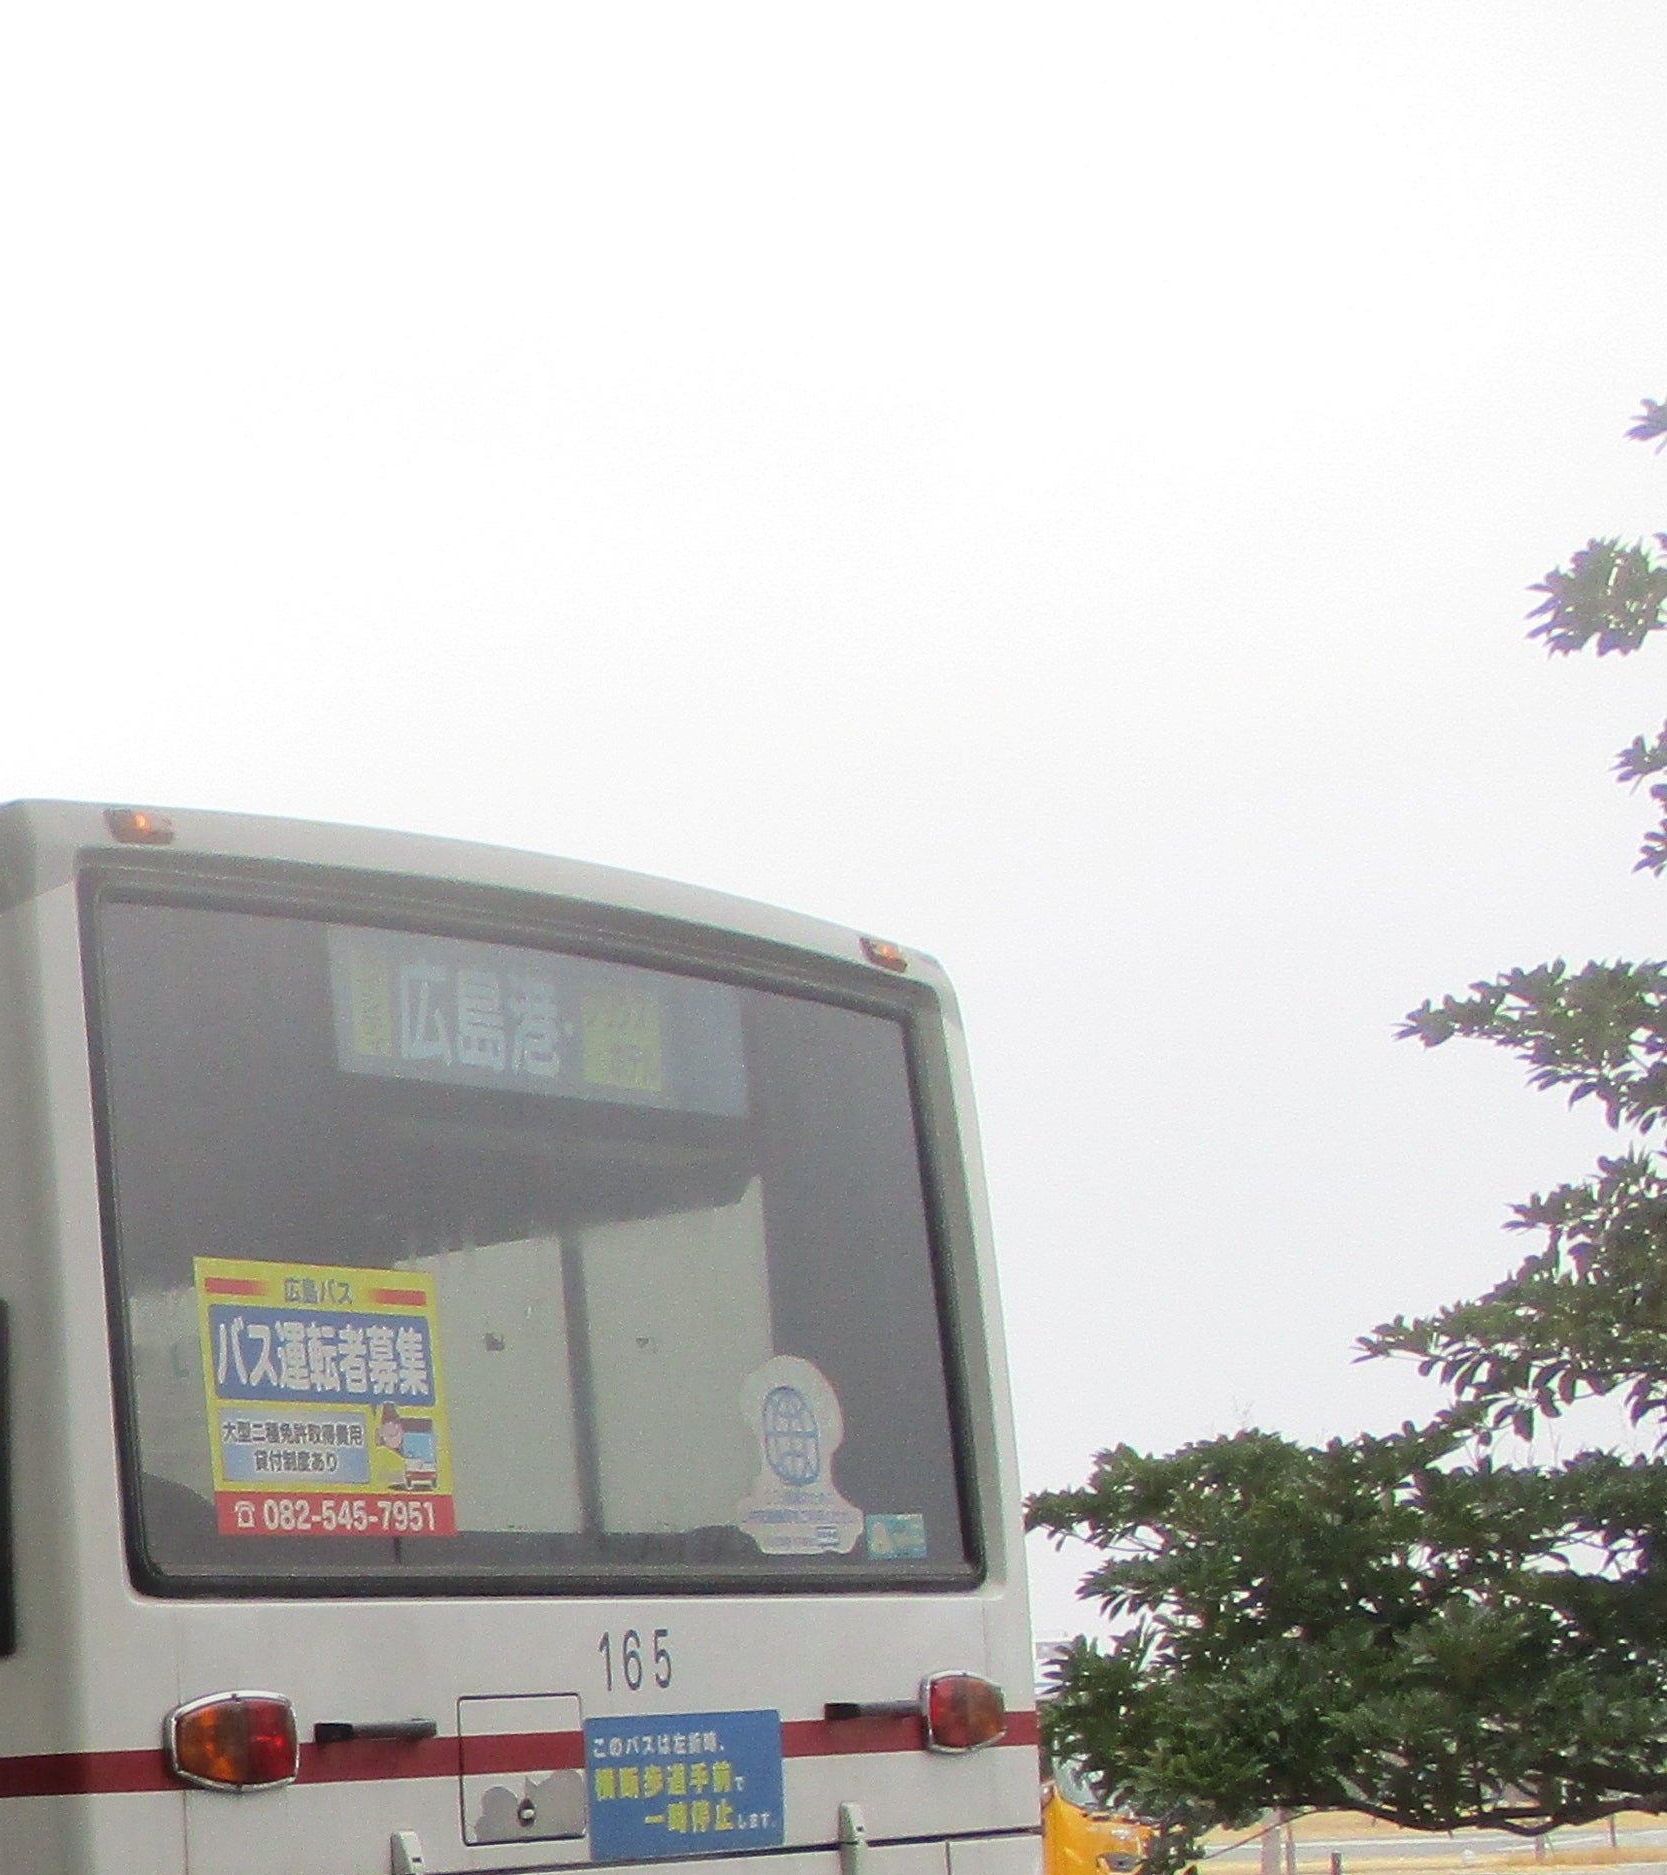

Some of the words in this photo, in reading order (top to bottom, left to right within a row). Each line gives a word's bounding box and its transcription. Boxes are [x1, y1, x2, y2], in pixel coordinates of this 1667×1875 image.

[284, 1277, 353, 1304] 広島バス
[218, 1316, 429, 1395] バス運転者募集
[263, 1498, 435, 1532] 082-545-7951
[598, 1628, 672, 1692] 165
